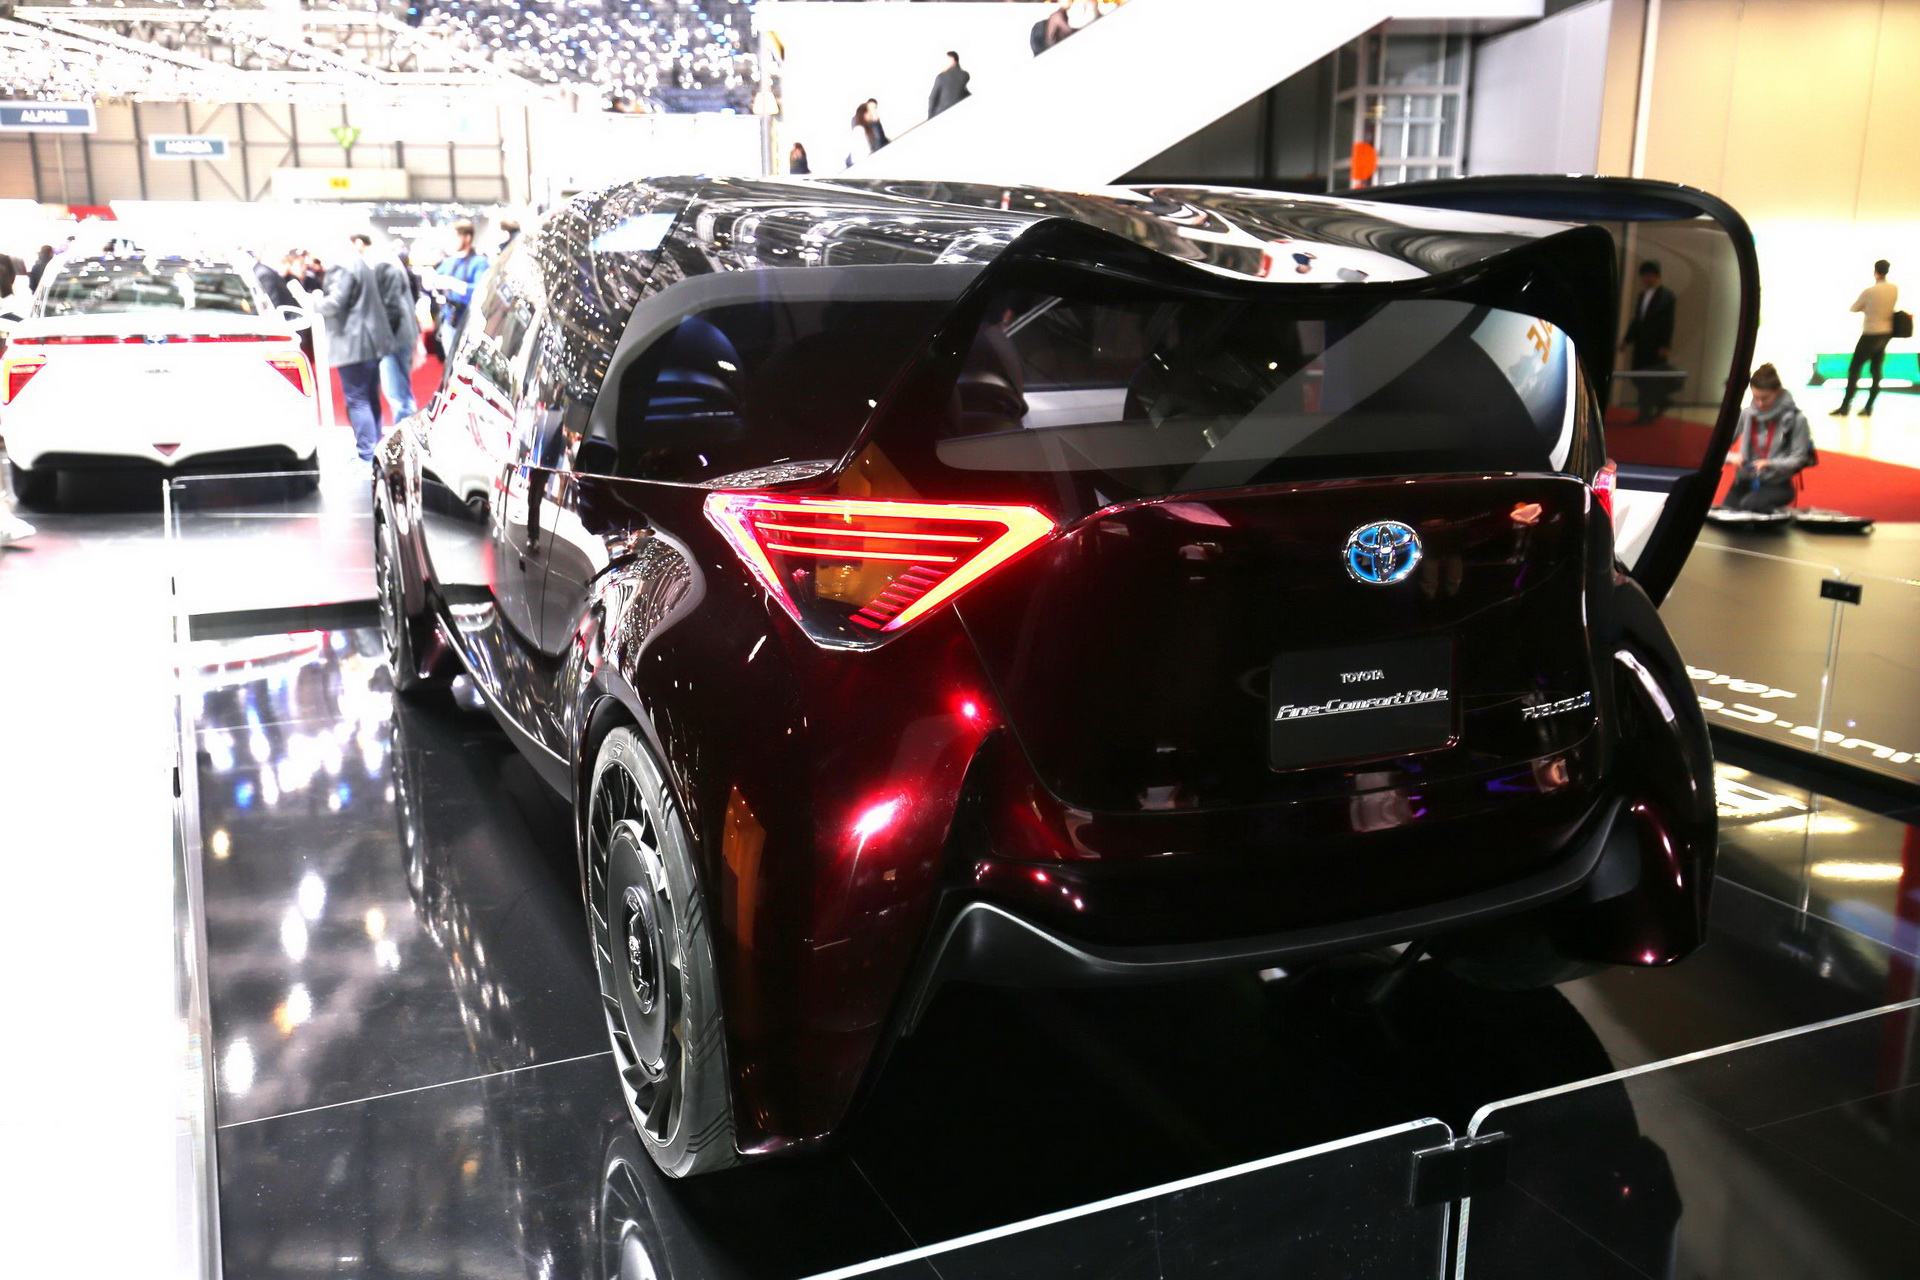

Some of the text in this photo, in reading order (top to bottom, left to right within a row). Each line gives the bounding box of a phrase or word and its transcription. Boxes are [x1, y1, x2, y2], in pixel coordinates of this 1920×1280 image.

[20, 109, 69, 124] ALPINE
[1340, 669, 1385, 684] TOYOTA
[1686, 664, 1797, 698] TOYO
[1404, 687, 1449, 704] Ride
